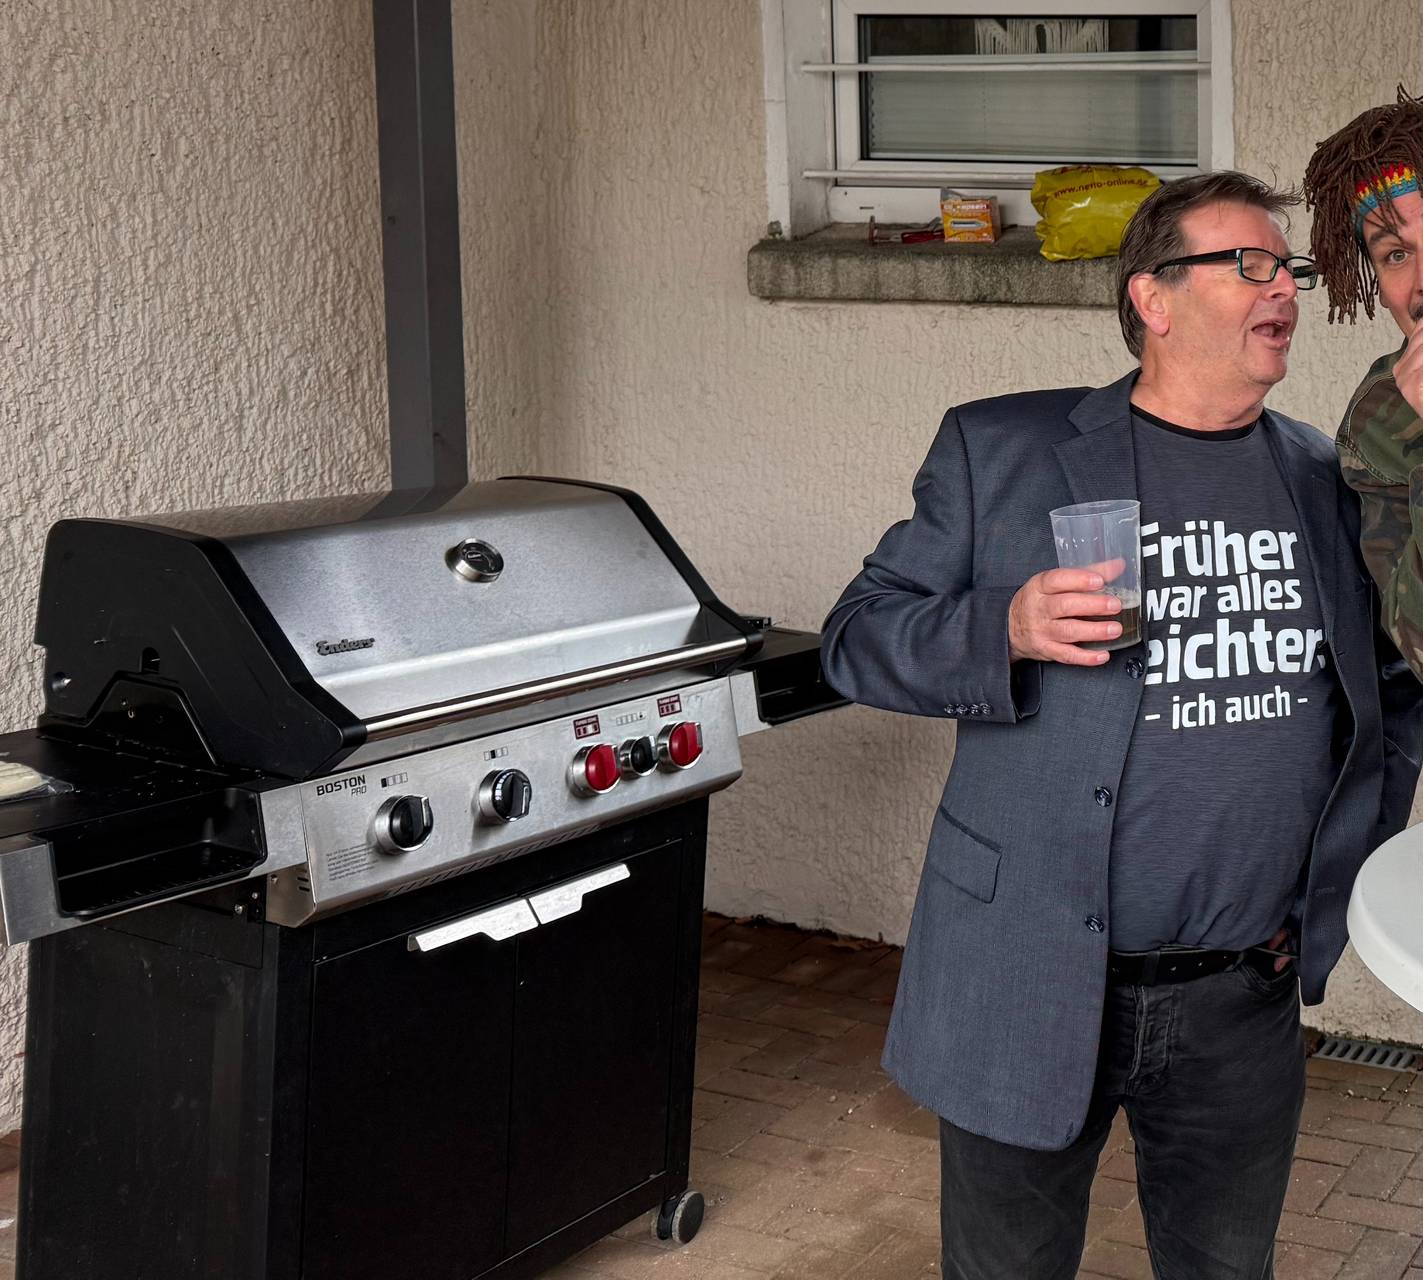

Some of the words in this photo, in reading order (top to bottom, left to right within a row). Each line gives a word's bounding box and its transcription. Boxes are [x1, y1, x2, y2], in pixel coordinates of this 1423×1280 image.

[1146, 585, 1208, 622] war
[1216, 572, 1302, 613] alles
[316, 638, 376, 656] Enders
[1171, 692, 1216, 729] ich
[1225, 685, 1291, 723] auch
[316, 774, 367, 796] BOSTON
[351, 785, 367, 796] PRO
